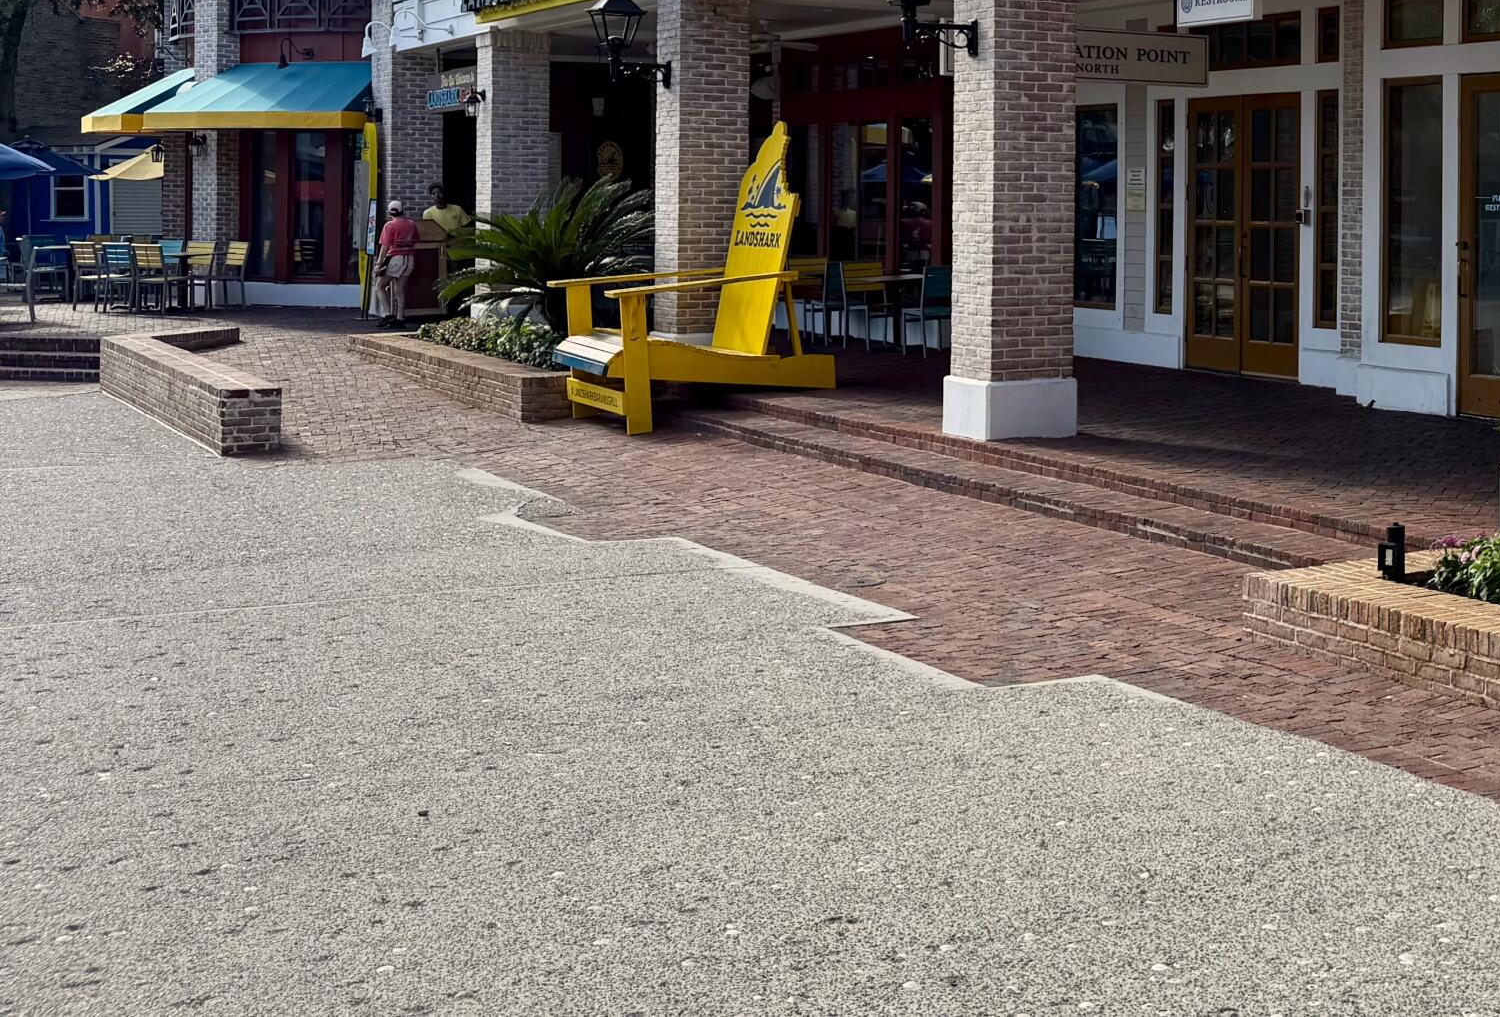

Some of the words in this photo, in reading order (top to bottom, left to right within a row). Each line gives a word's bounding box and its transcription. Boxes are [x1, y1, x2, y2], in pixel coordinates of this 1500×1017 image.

[1076, 45, 1129, 61] ATION
[1136, 48, 1191, 65] POINT
[1076, 63, 1120, 75] NORTH
[734, 229, 782, 249] LANDSHARK
